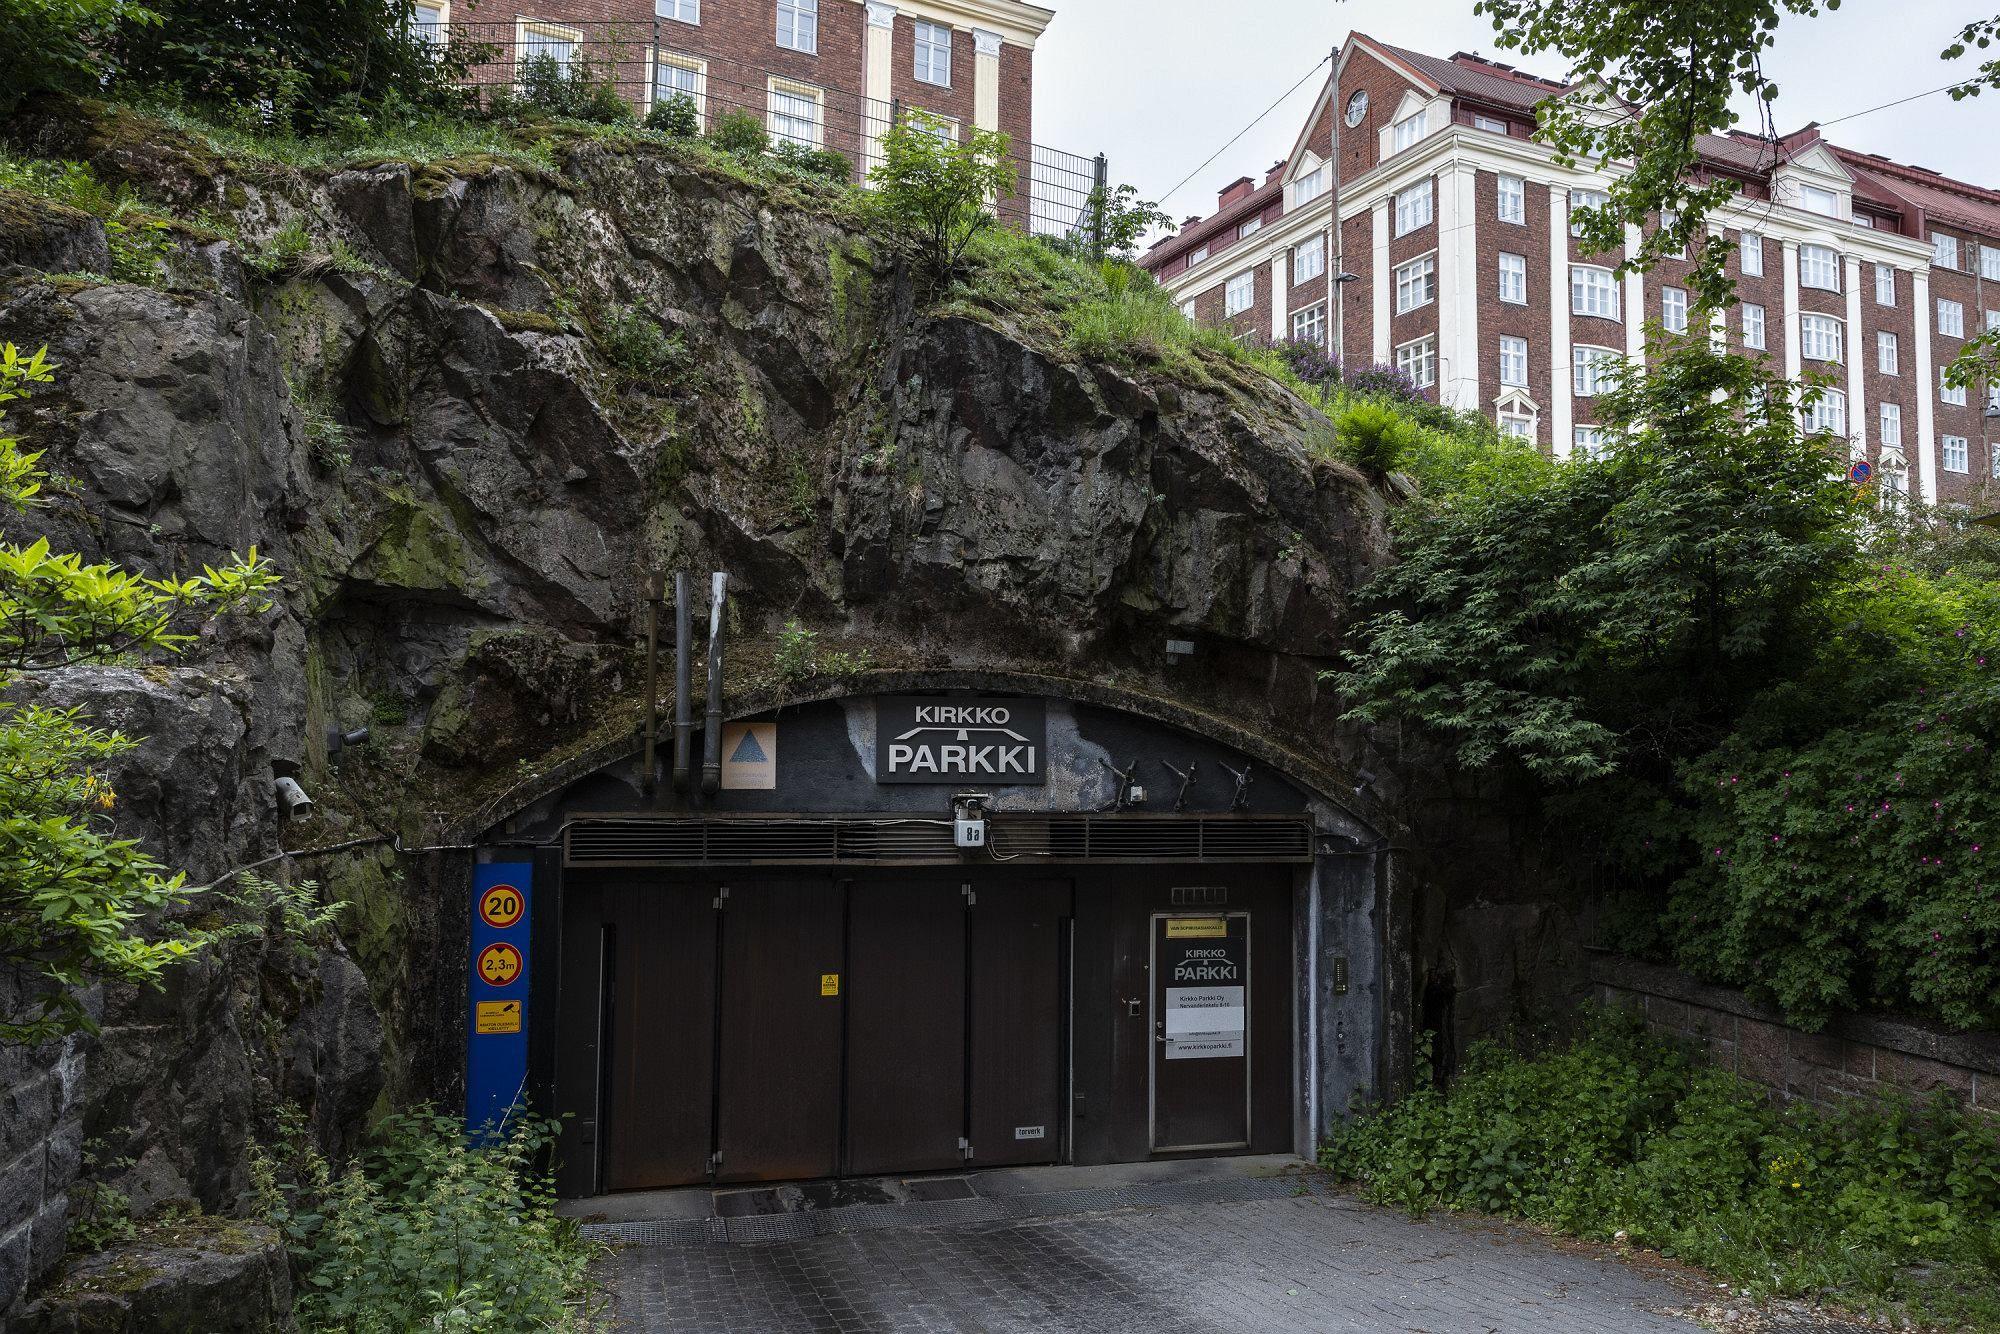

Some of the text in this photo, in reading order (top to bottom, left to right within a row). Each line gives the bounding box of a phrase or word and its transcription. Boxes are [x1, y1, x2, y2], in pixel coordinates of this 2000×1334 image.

[915, 706, 1010, 725] KIRKKO
[888, 744, 1035, 773] PARKKI
[966, 827, 980, 841] 8a
[488, 897, 516, 915] 20
[1185, 949, 1226, 958] KIRKKO
[485, 959, 515, 972] 2,3m
[1174, 966, 1237, 981] PARKKI
